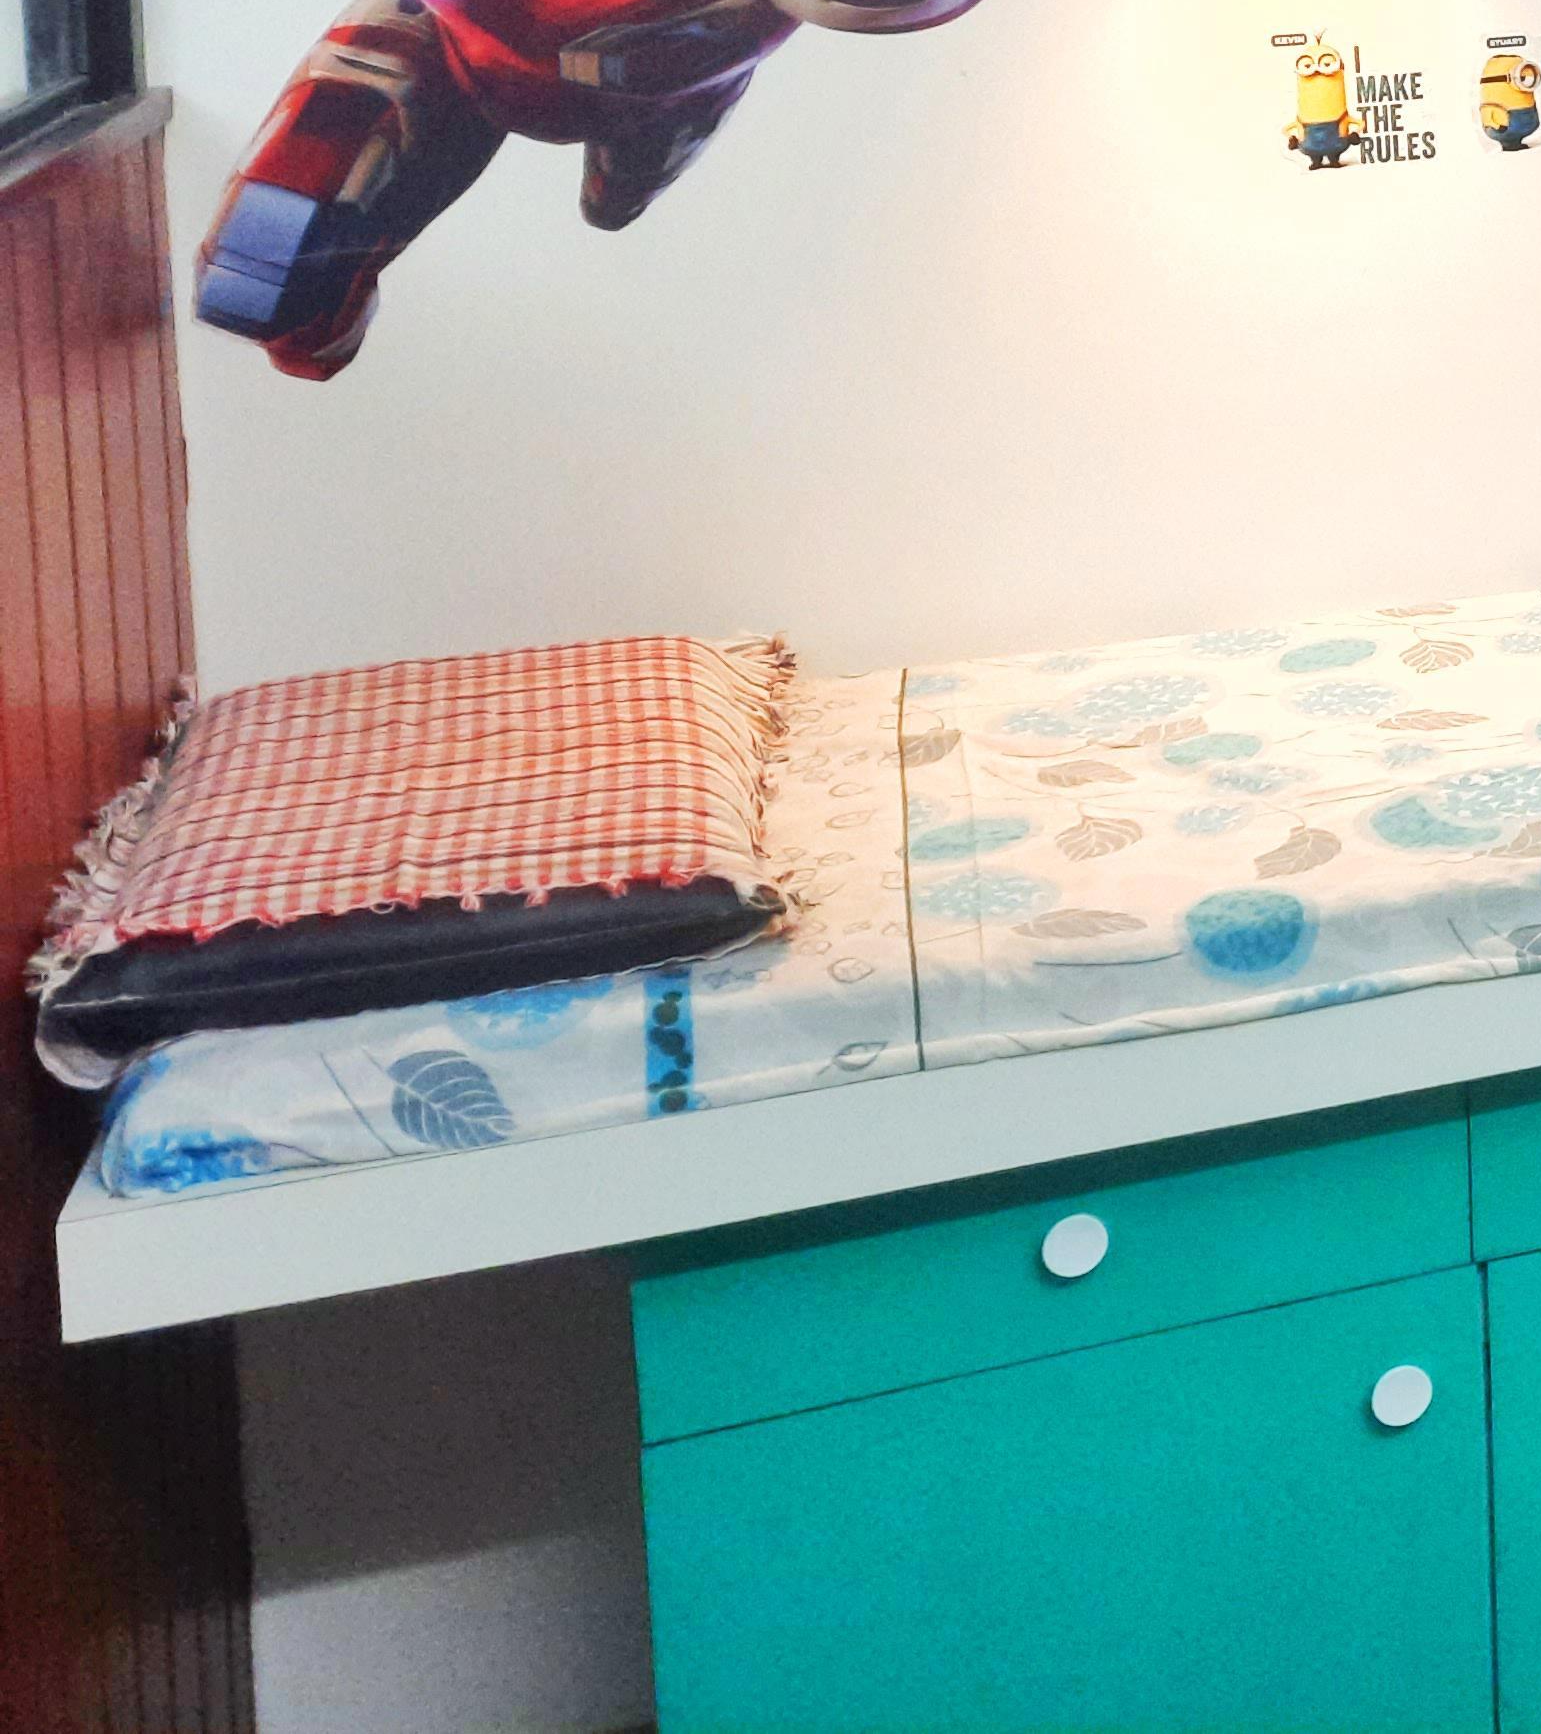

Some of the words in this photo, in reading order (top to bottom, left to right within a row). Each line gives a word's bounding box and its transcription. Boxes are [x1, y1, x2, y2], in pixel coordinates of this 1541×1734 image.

[1354, 45, 1361, 73] I
[1356, 72, 1424, 104] MAKE
[1356, 103, 1405, 134] THE
[1359, 131, 1437, 164] RULES
